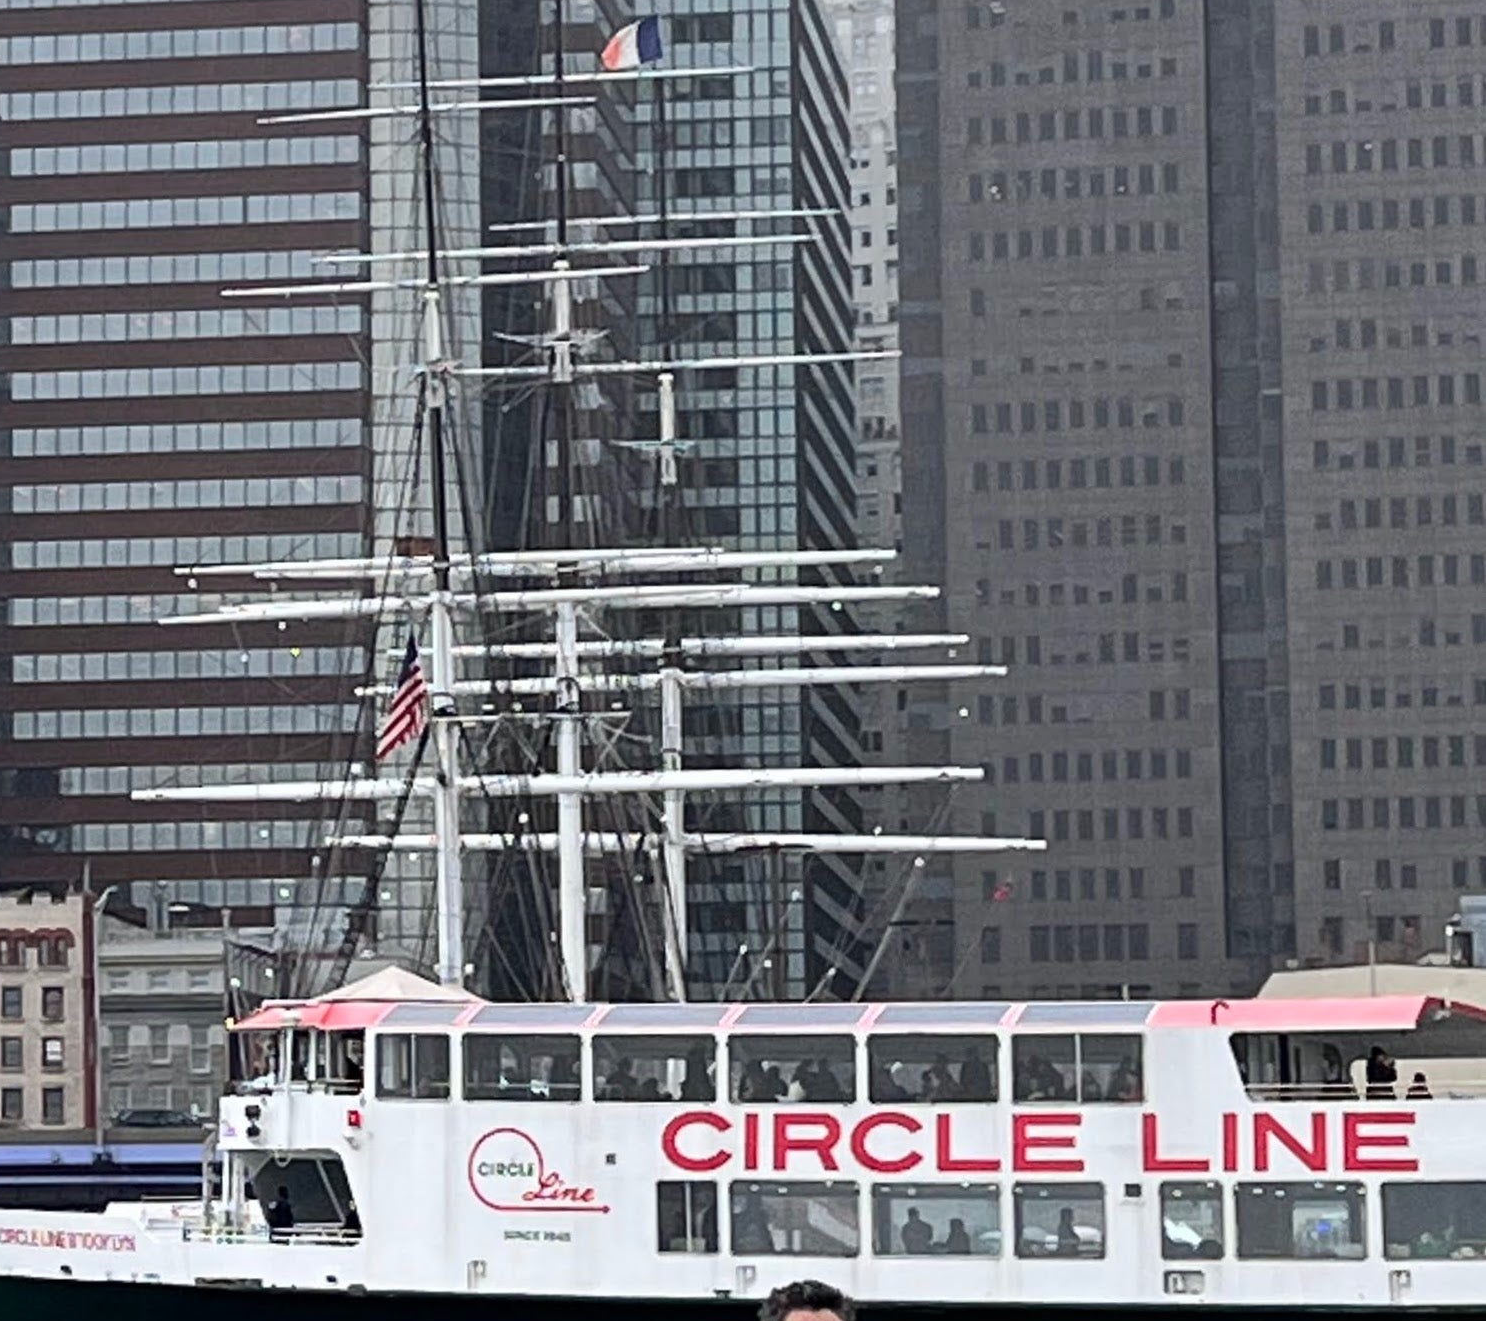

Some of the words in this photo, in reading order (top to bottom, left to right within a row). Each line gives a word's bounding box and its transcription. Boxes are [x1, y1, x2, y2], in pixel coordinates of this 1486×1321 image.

[662, 1111, 1084, 1172] CIRCLE
[1143, 1111, 1419, 1172] LINE
[477, 1162, 534, 1177] CIRCLE
[522, 1171, 595, 1202] Line
